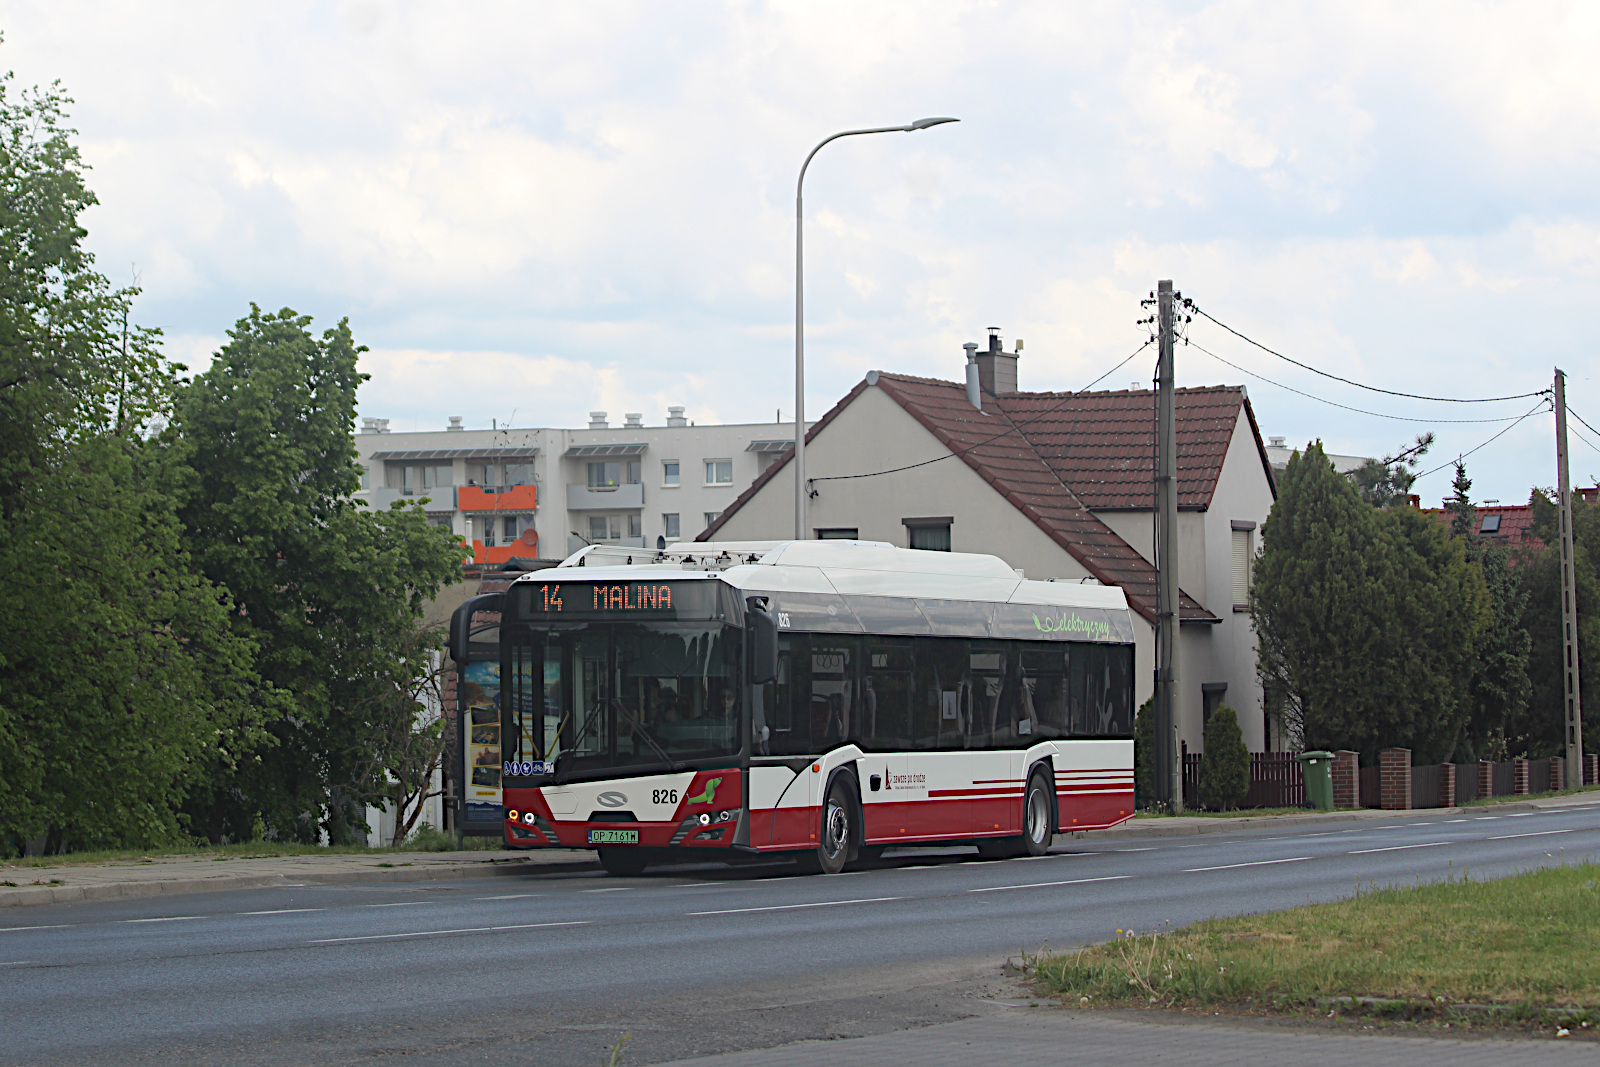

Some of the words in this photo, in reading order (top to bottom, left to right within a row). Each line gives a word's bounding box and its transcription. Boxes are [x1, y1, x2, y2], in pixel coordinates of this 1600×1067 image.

[540, 584, 563, 611] 14
[593, 585, 671, 609] MALINA
[778, 612, 790, 627] 826
[1060, 612, 1109, 640] elektryczny
[652, 789, 678, 804] 826
